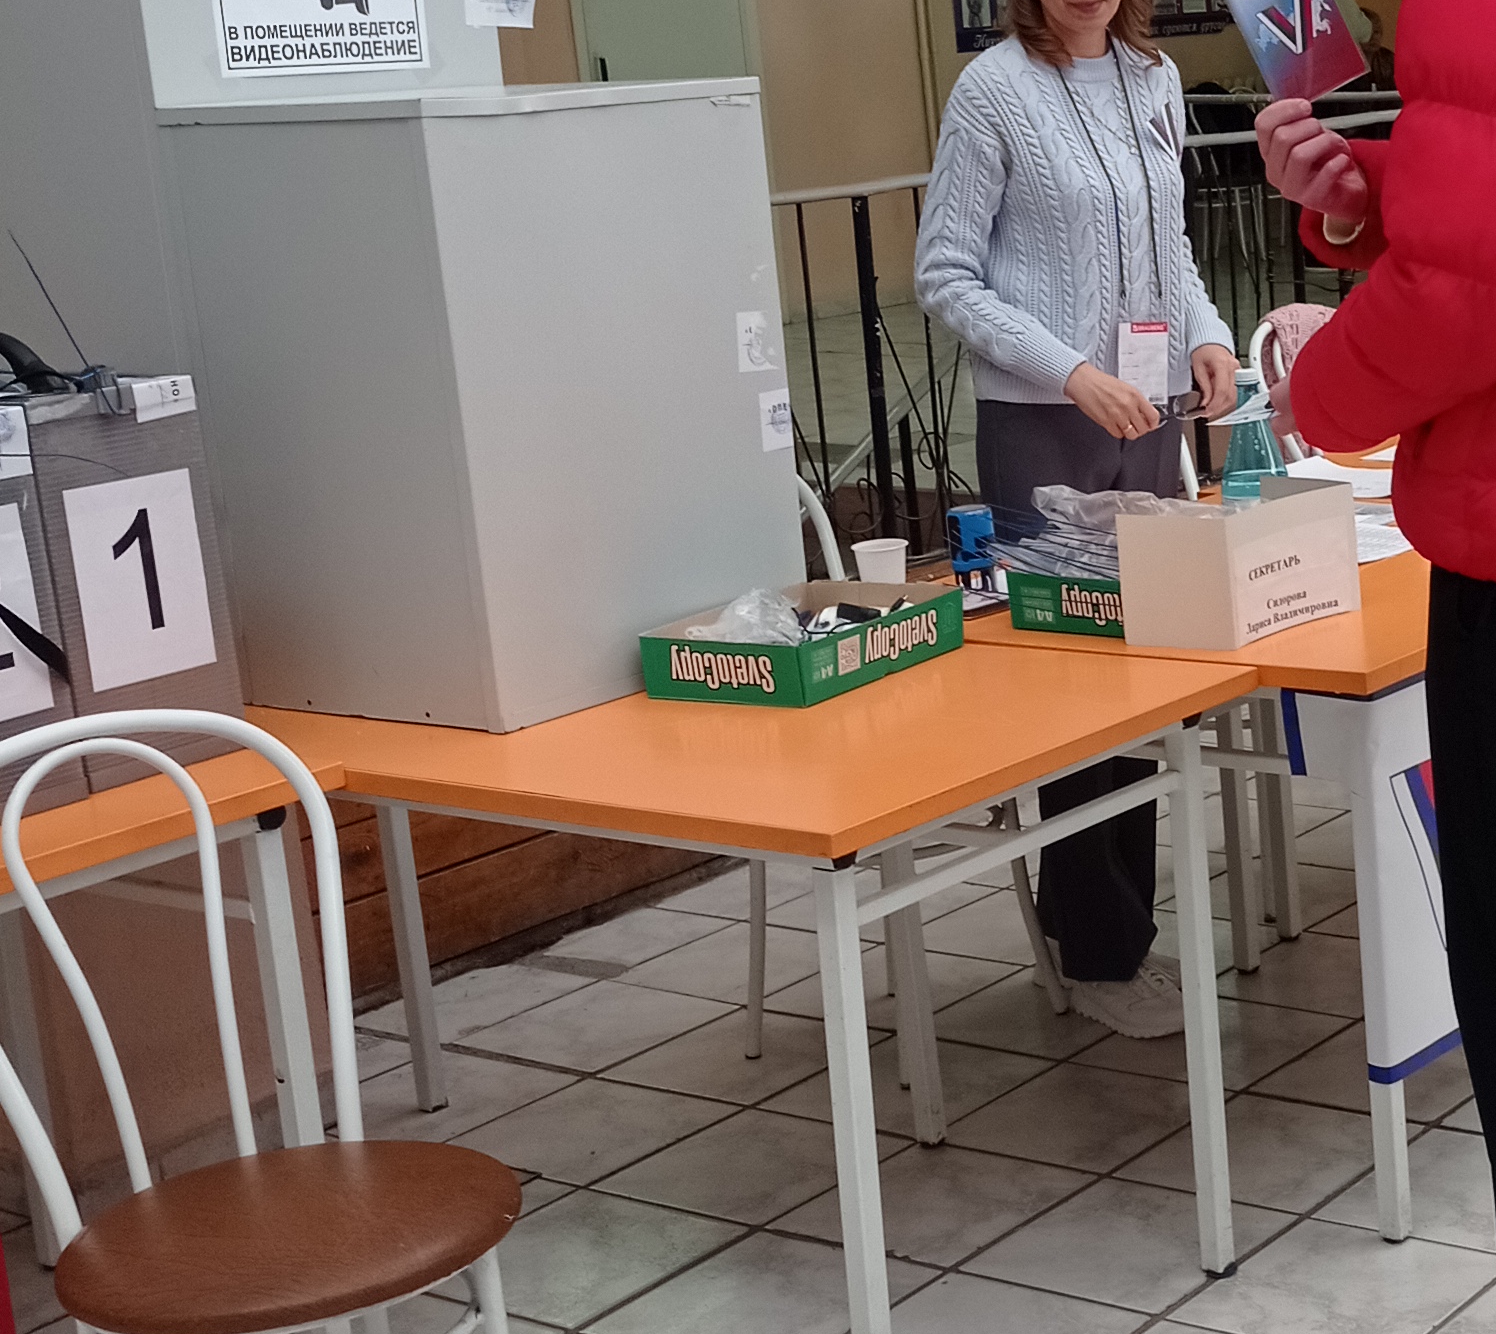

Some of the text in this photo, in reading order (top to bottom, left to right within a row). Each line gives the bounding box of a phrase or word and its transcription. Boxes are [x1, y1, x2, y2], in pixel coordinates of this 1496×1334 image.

[228, 20, 416, 40] В ПОМЕЩЕНИИ ВЕДЕТСЯ
[230, 39, 418, 64] ВИДЕОНАБЛЮДЕНИЕ
[112, 508, 165, 630] 1
[1248, 554, 1301, 581] СЕКРЕТАРЬ
[1061, 583, 1123, 626] toCopy
[1273, 599, 1339, 624] Владимировна
[865, 609, 937, 663] SvetoCopy
[670, 644, 776, 694] SvetoCopy
